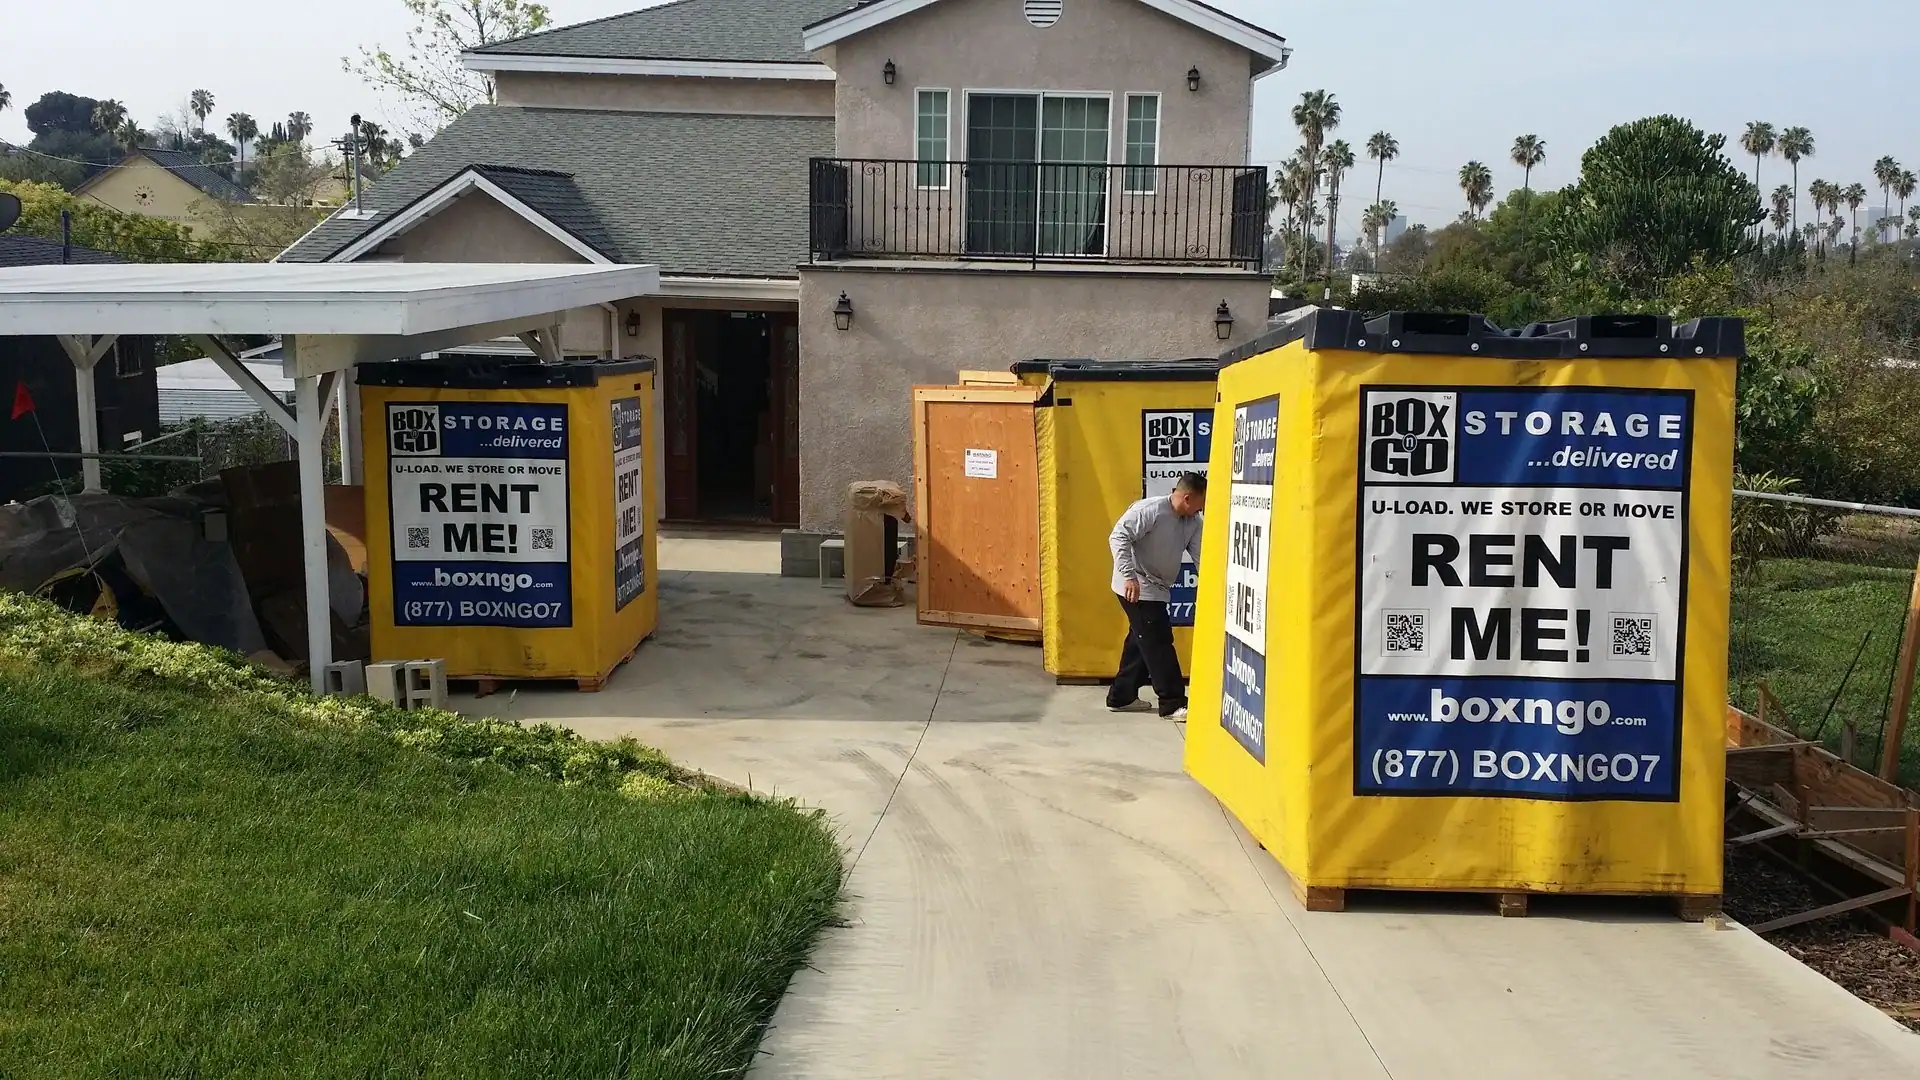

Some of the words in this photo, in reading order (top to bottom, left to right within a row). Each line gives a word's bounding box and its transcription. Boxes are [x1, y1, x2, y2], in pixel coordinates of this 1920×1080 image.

[392, 409, 436, 431] BOX
[444, 415, 563, 431] STORAGE
[1149, 416, 1190, 437] BOX
[1246, 417, 1277, 442] STORAGE
[1372, 398, 1449, 438] BOX
[1464, 410, 1681, 438] STORAGE
[394, 431, 437, 452] GO
[480, 435, 562, 449] ...delivered
[1149, 438, 1190, 458] GO
[395, 465, 442, 474] U-LOAD.
[445, 465, 463, 474] WE
[467, 465, 504, 474] STORE
[508, 465, 525, 475] OR
[528, 466, 561, 475] MOVE
[1371, 438, 1448, 476] GO
[1528, 446, 1678, 470] ...delivered
[419, 482, 539, 514] RENT
[618, 468, 639, 503] RENT
[622, 505, 637, 538] ME!
[1371, 500, 1454, 515] U-LOAD.
[1461, 501, 1493, 515] WE
[1501, 501, 1572, 516] STORE
[1579, 502, 1606, 517] OR
[1613, 503, 1675, 519] MOVE
[443, 523, 518, 553] ME!
[1233, 521, 1262, 572] RENT
[1411, 533, 1630, 589] RENT
[411, 567, 553, 593] www.boxngo.com
[404, 601, 453, 621] (877)
[460, 601, 562, 619] BOXNGO7
[1450, 607, 1591, 663] ME!
[1387, 688, 1647, 735] www.boxngo.com
[1372, 748, 1460, 785] (877)
[1473, 750, 1661, 783] BOXNGO7
